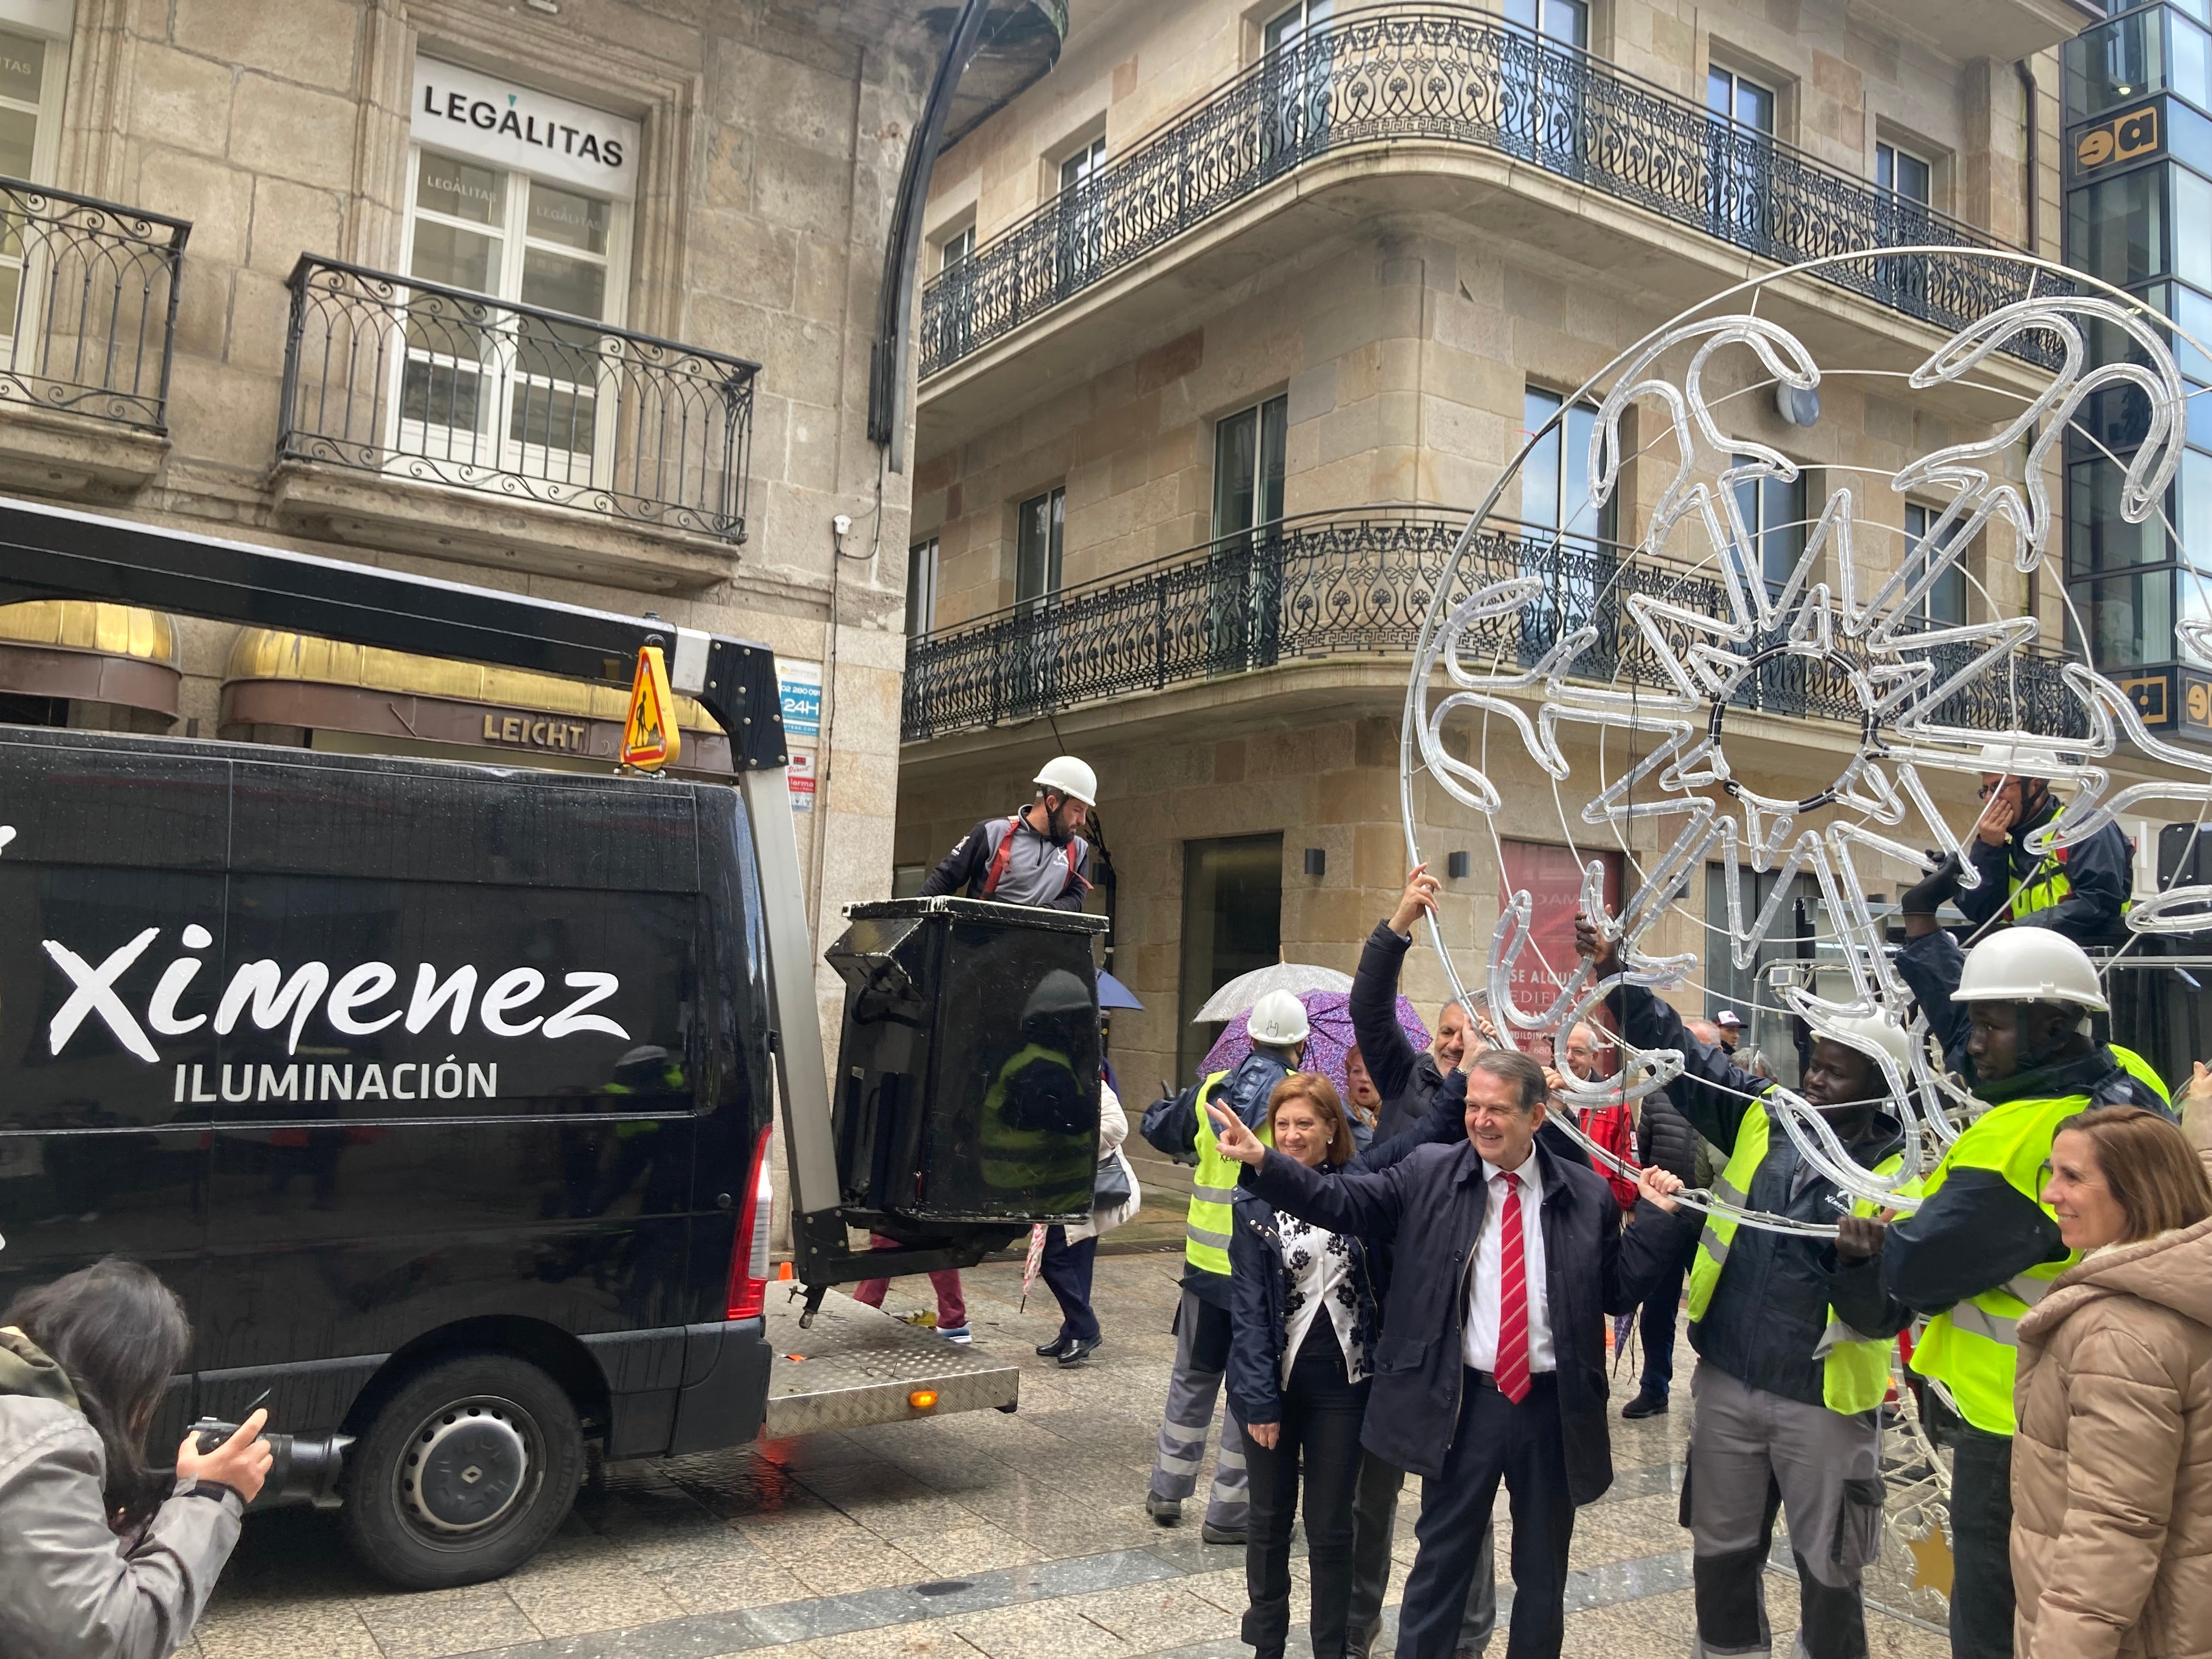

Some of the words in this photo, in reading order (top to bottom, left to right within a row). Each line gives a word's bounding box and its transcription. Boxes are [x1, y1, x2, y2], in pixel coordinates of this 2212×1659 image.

[0, 57, 31, 75] TAS
[792, 686, 808, 695] 280
[783, 698, 820, 716] 24H
[484, 714, 584, 749] LEICHT
[790, 778, 814, 788] larma
[1510, 969, 1525, 984] SE
[42, 924, 630, 1063] Ximenez
[174, 1054, 497, 1102] ILUMINACIÓN
